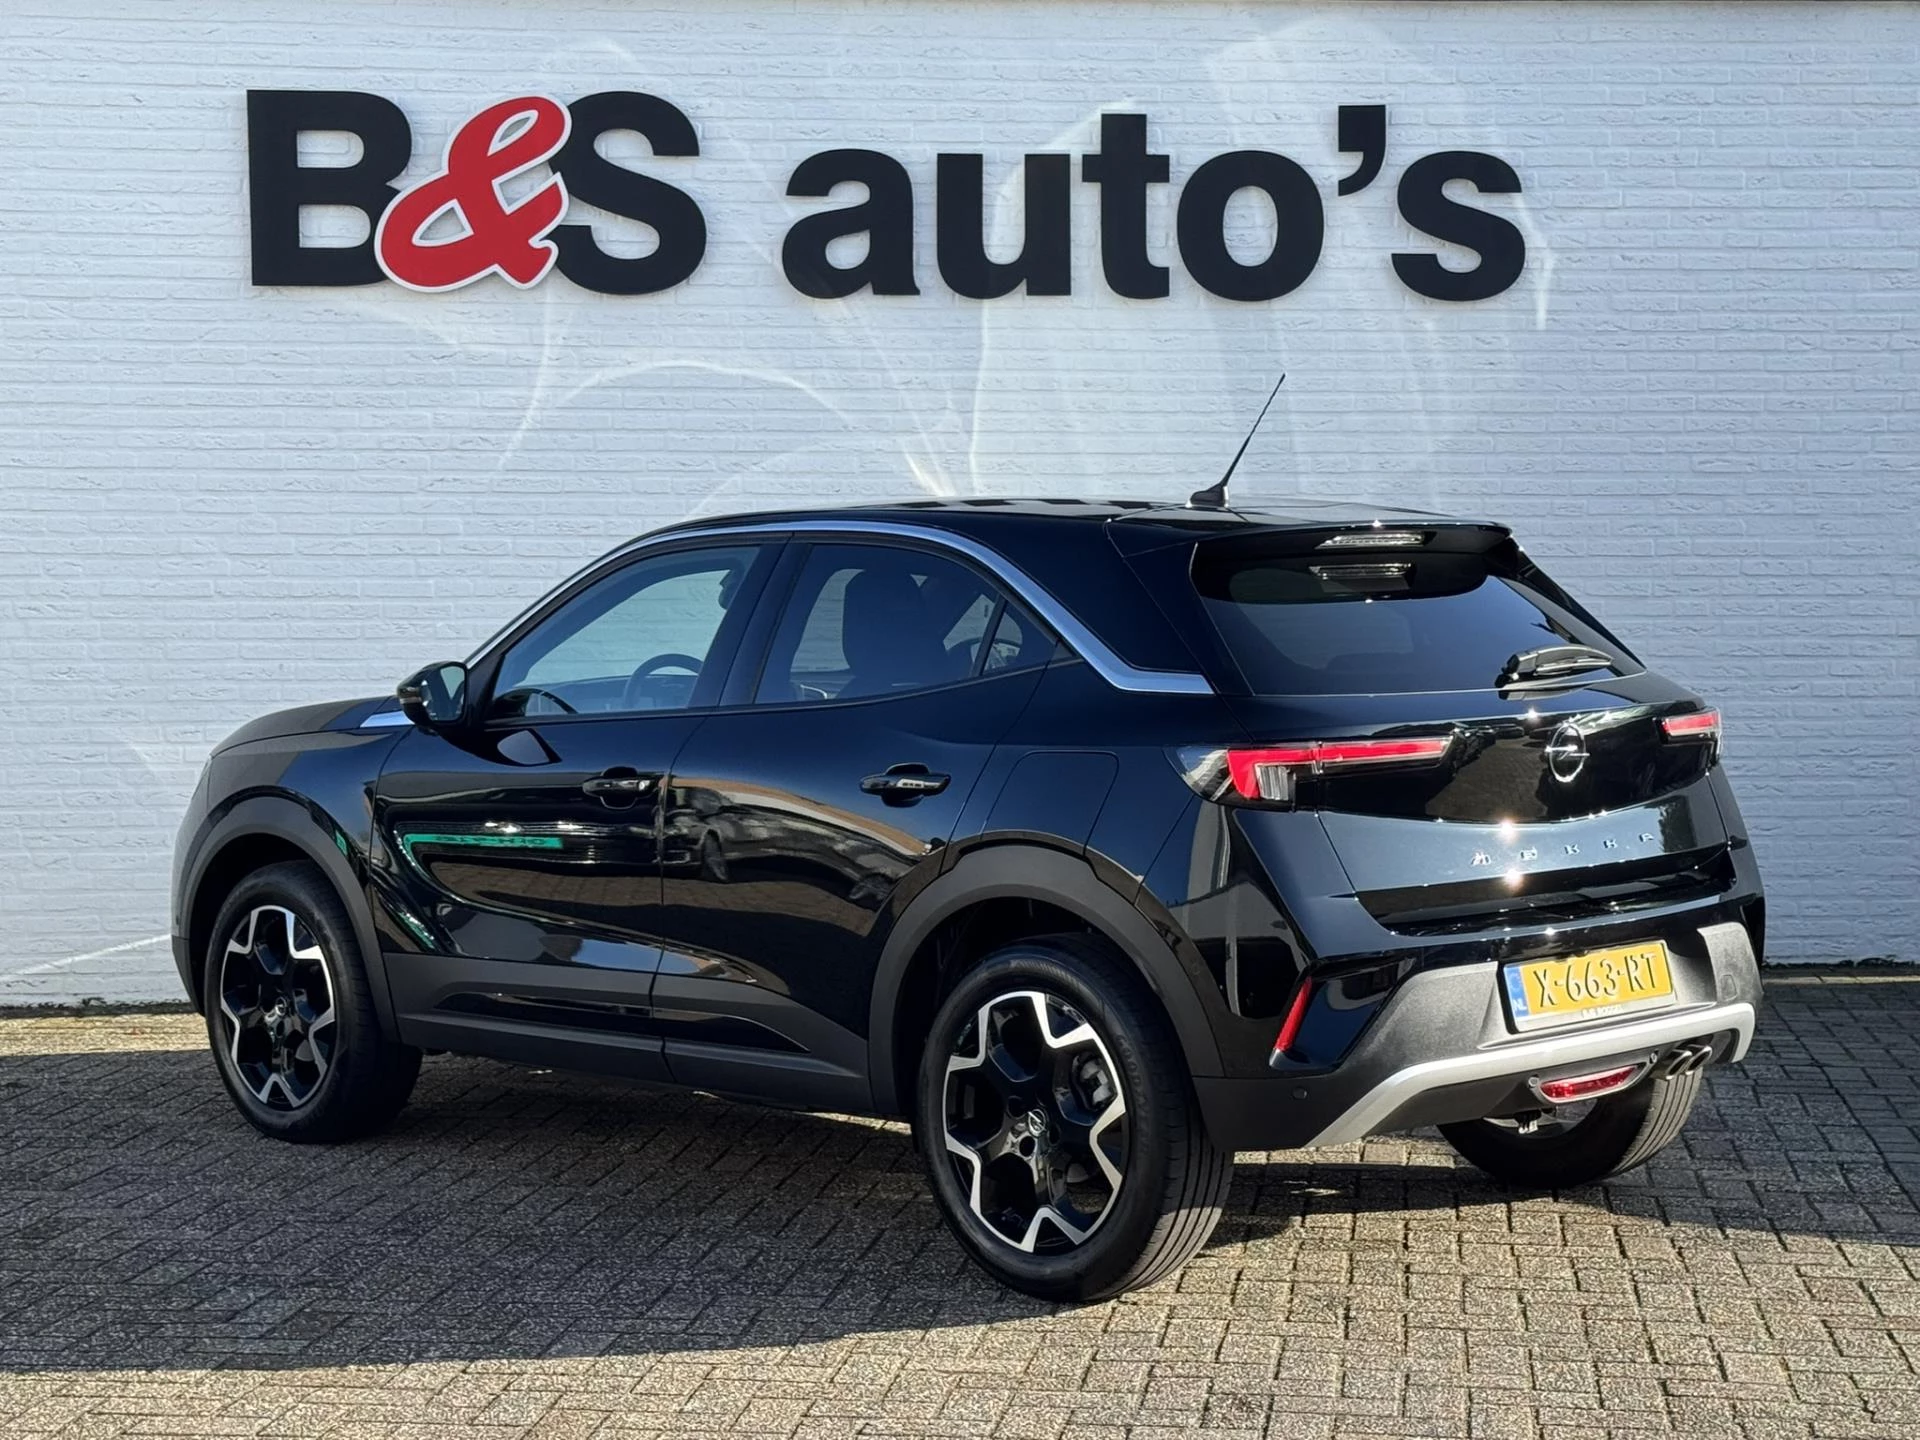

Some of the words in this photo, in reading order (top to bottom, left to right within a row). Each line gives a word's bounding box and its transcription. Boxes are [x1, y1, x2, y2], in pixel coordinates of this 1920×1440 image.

[247, 90, 706, 295] B&S
[782, 105, 1526, 302] auto's
[1512, 998, 1527, 1012] NL
[1533, 952, 1656, 1008] X-663-RT
